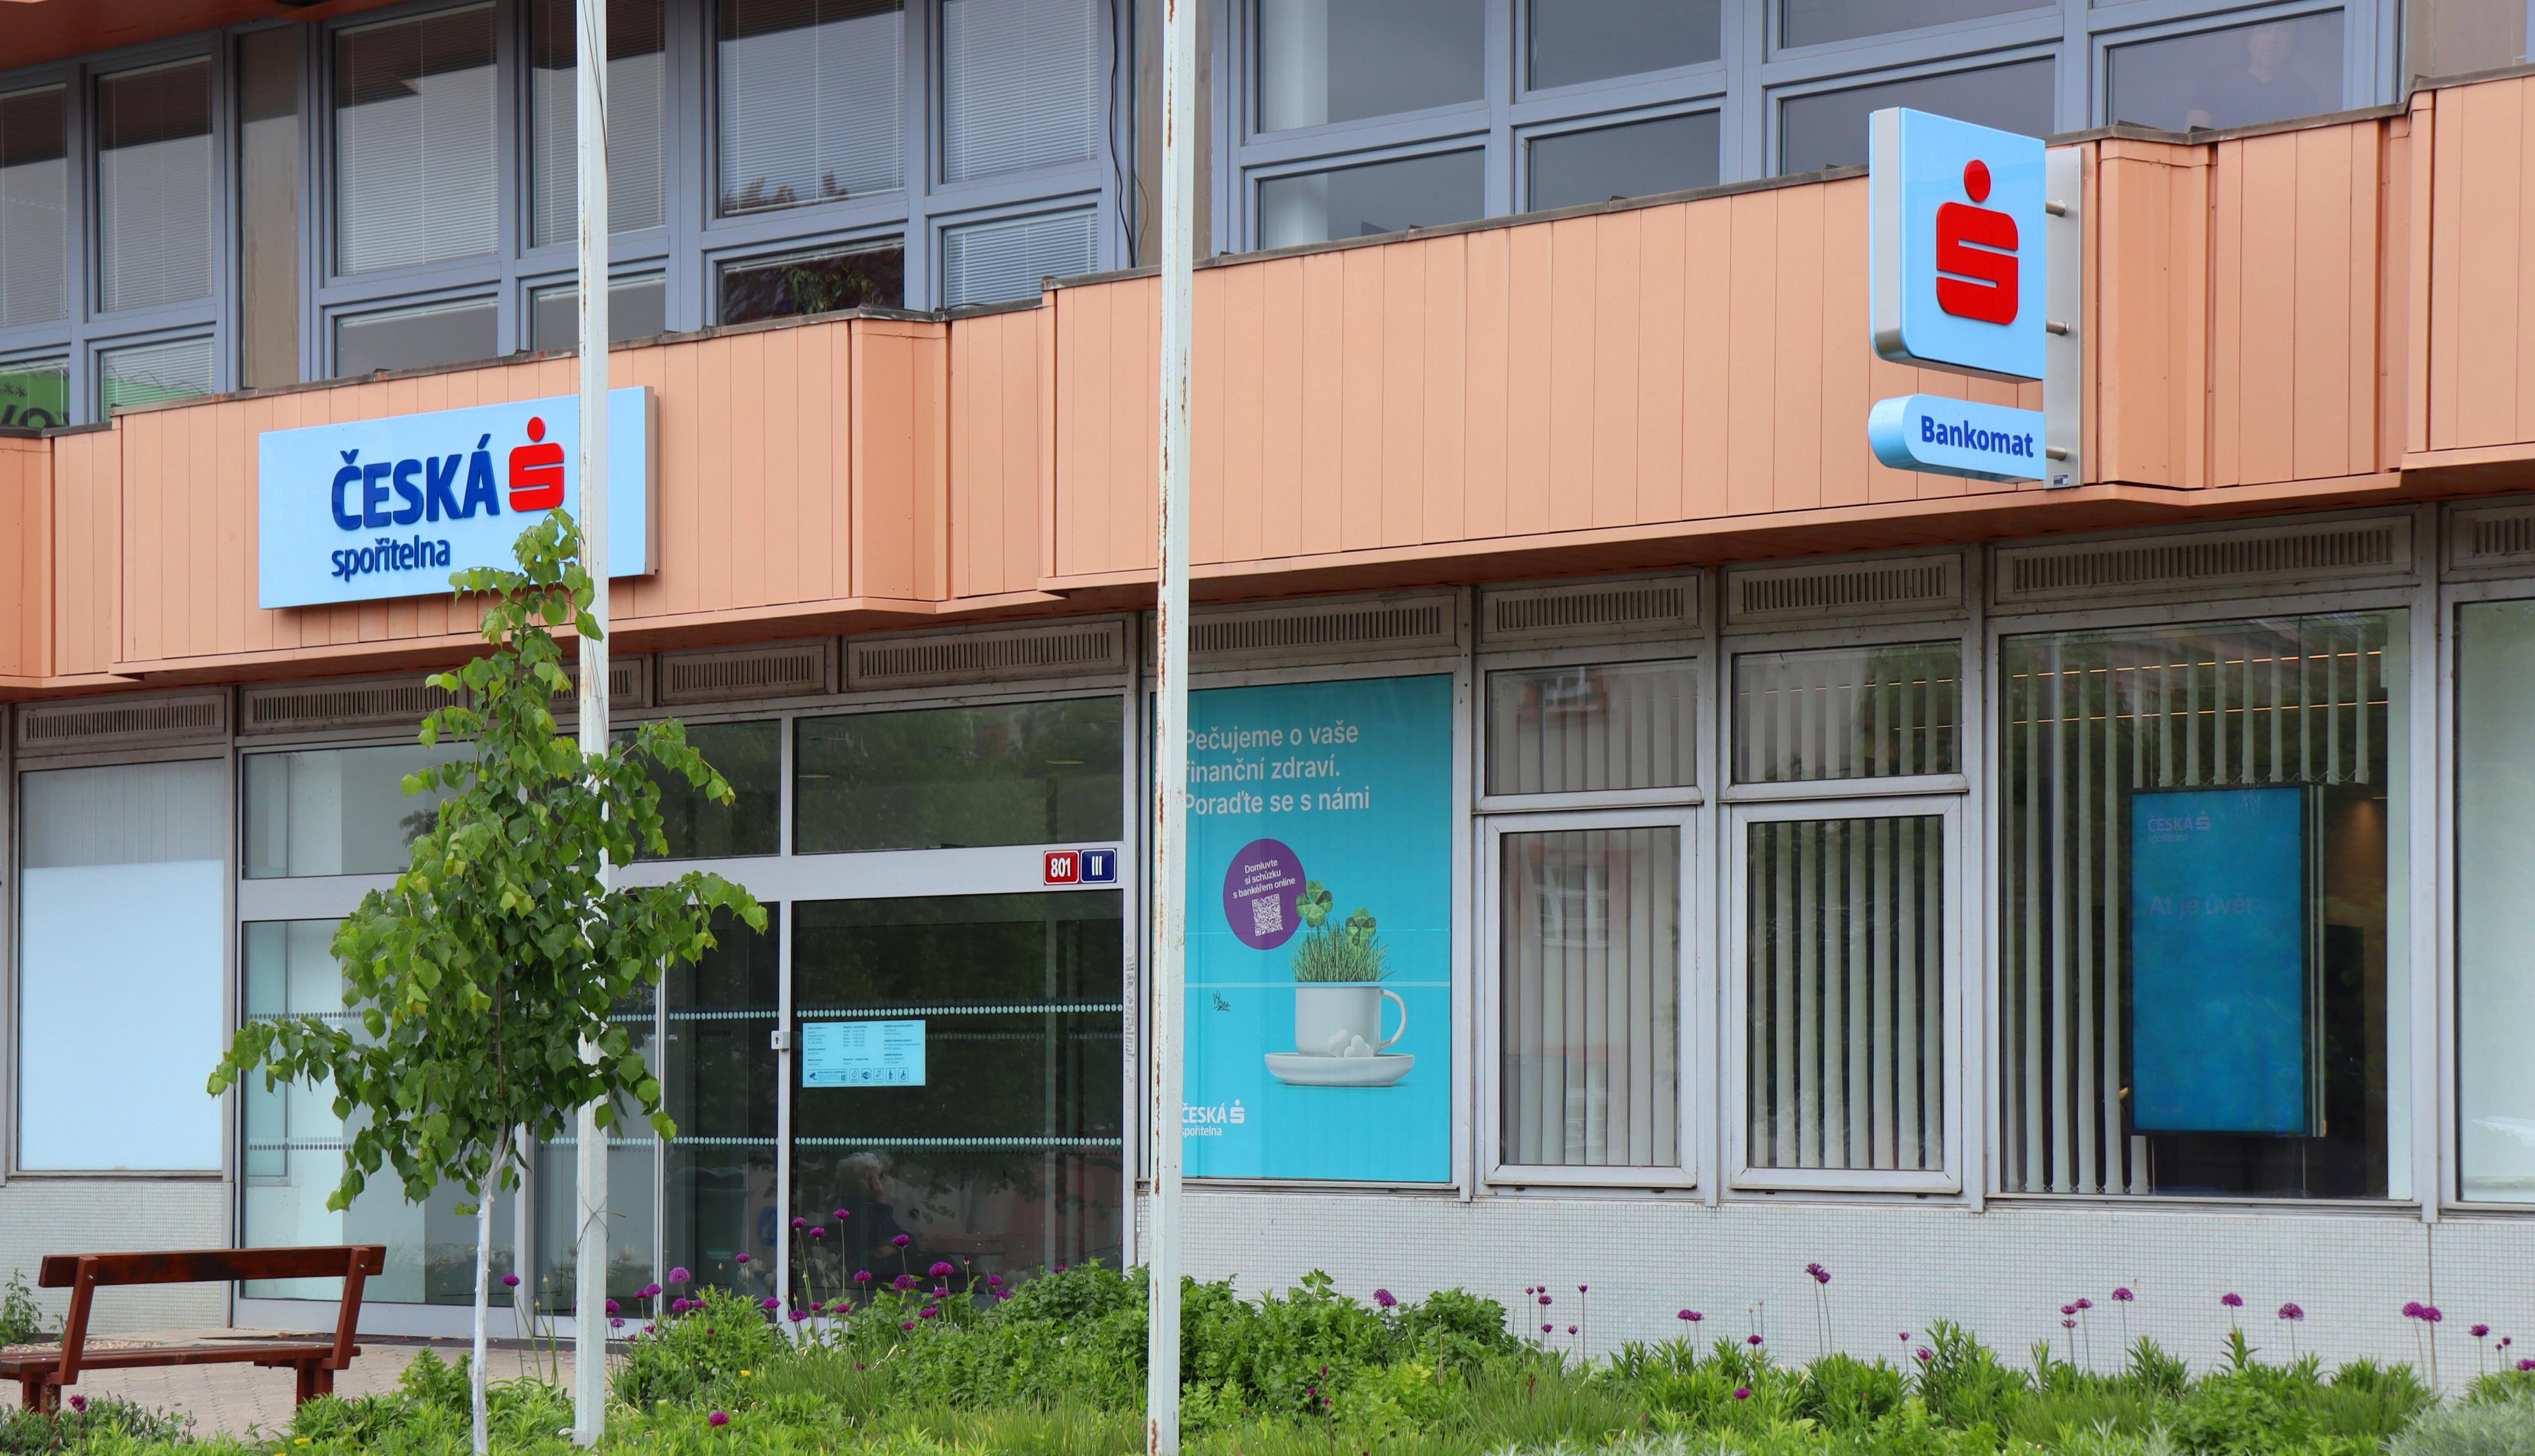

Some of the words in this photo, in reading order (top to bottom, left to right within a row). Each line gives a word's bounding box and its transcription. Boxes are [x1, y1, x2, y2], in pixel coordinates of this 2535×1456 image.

[1921, 415, 2034, 458] Bankomat
[331, 433, 500, 530] ČESKÁ
[331, 534, 451, 582] spořitelna
[1290, 729, 1302, 746] o
[1309, 720, 1359, 744] vaše
[1271, 753, 1340, 780] zdraví.
[1270, 797, 1293, 813] se
[1300, 794, 1312, 811] s
[1319, 785, 1370, 811] námi
[1050, 857, 1071, 878] 801
[1244, 859, 1278, 874] Domluvte
[1245, 875, 1251, 885] si
[1252, 869, 1281, 884] schůzku
[1238, 883, 1273, 898] bankéřem
[1274, 877, 1295, 889] online
[1182, 1102, 1227, 1123] ČESKÁ
